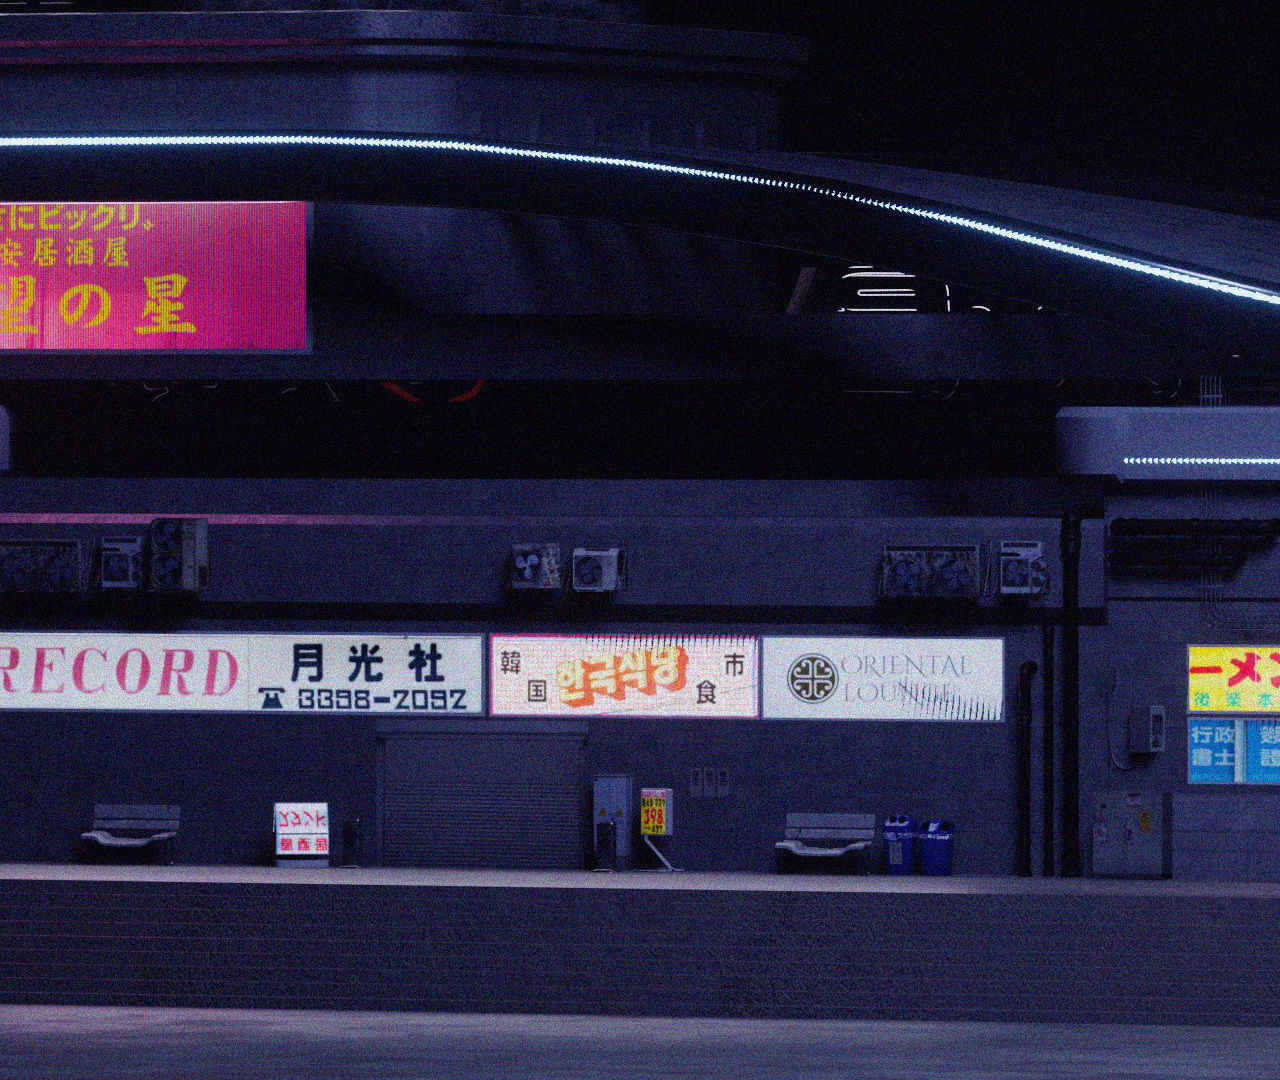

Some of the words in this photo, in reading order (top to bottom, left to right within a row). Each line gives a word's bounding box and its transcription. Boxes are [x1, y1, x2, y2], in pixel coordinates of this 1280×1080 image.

[290, 643, 445, 683] 月光社
[840, 653, 976, 678] ORIENTAL
